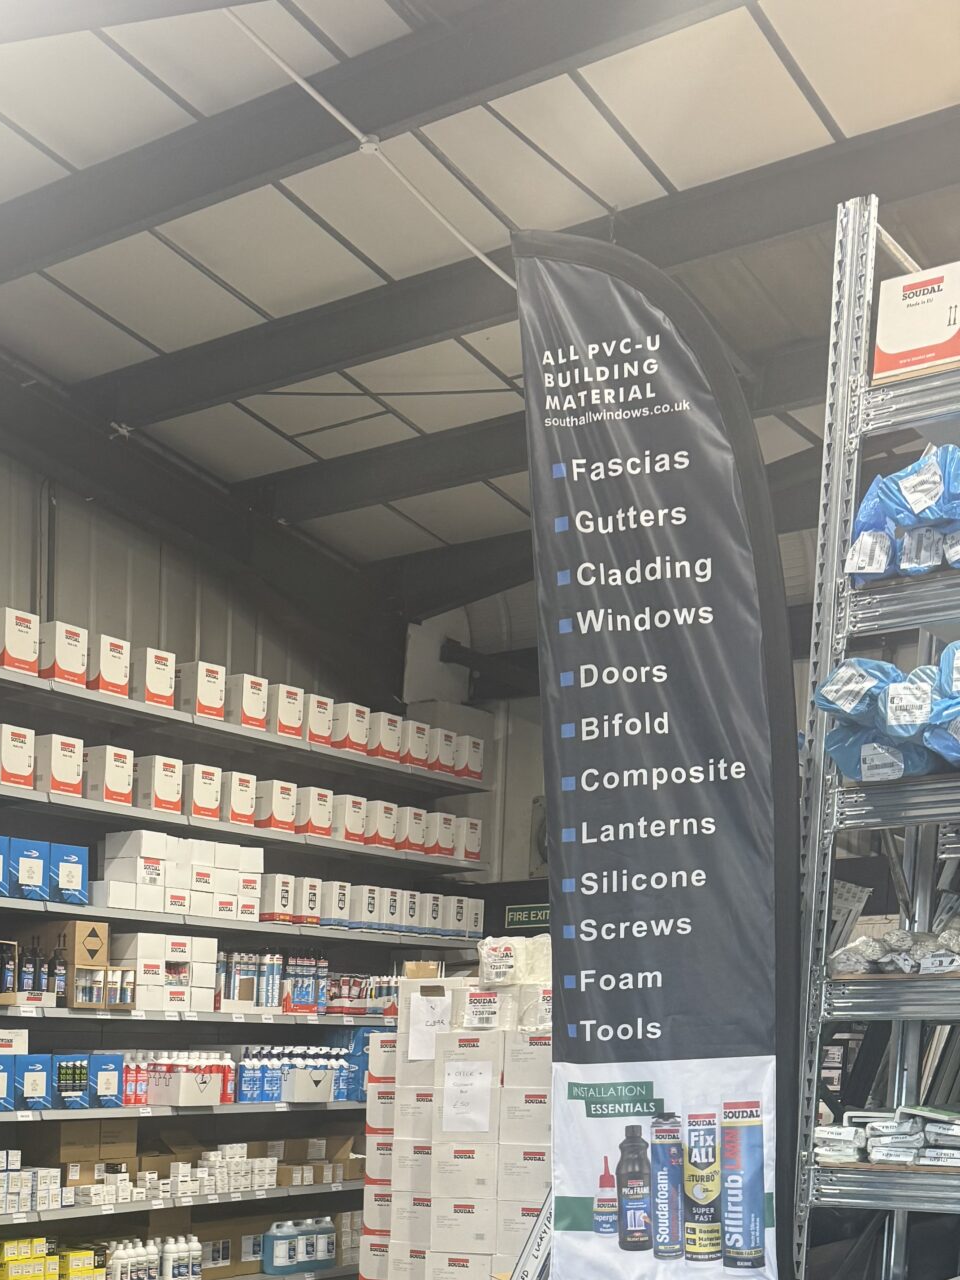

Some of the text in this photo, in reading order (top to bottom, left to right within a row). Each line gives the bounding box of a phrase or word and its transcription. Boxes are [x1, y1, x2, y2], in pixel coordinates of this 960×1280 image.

[902, 284, 943, 301] SOUDAL
[542, 334, 661, 366] ALL PVC-U
[544, 358, 659, 388] BUILDING
[545, 382, 656, 411] MATERIAL
[544, 400, 690, 428] southallwindows.co.uk
[571, 449, 690, 482] Fascias
[575, 505, 687, 535] Gutters
[576, 556, 713, 586] Cladding
[576, 605, 714, 635] Windows
[579, 663, 668, 688] Doors
[581, 712, 670, 741] Bifold
[580, 758, 746, 792] Composite
[581, 815, 717, 844] Lanterns
[580, 867, 707, 895] Silicone
[509, 910, 550, 922] FIRE EXIT
[579, 916, 692, 942] Screws
[580, 969, 663, 992] Foam
[580, 1018, 662, 1042] Tools
[572, 1085, 646, 1098] INSTALLATION
[591, 1102, 656, 1114] ESSENTIALS
[723, 1109, 761, 1120] SOUDAL
[687, 1119, 717, 1127] SOUDAL
[690, 1130, 715, 1147] Fix
[690, 1147, 715, 1163] ALL
[691, 1174, 715, 1182] TURBO
[655, 1170, 670, 1243] Soudafoam
[724, 1175, 744, 1248] Silirub
